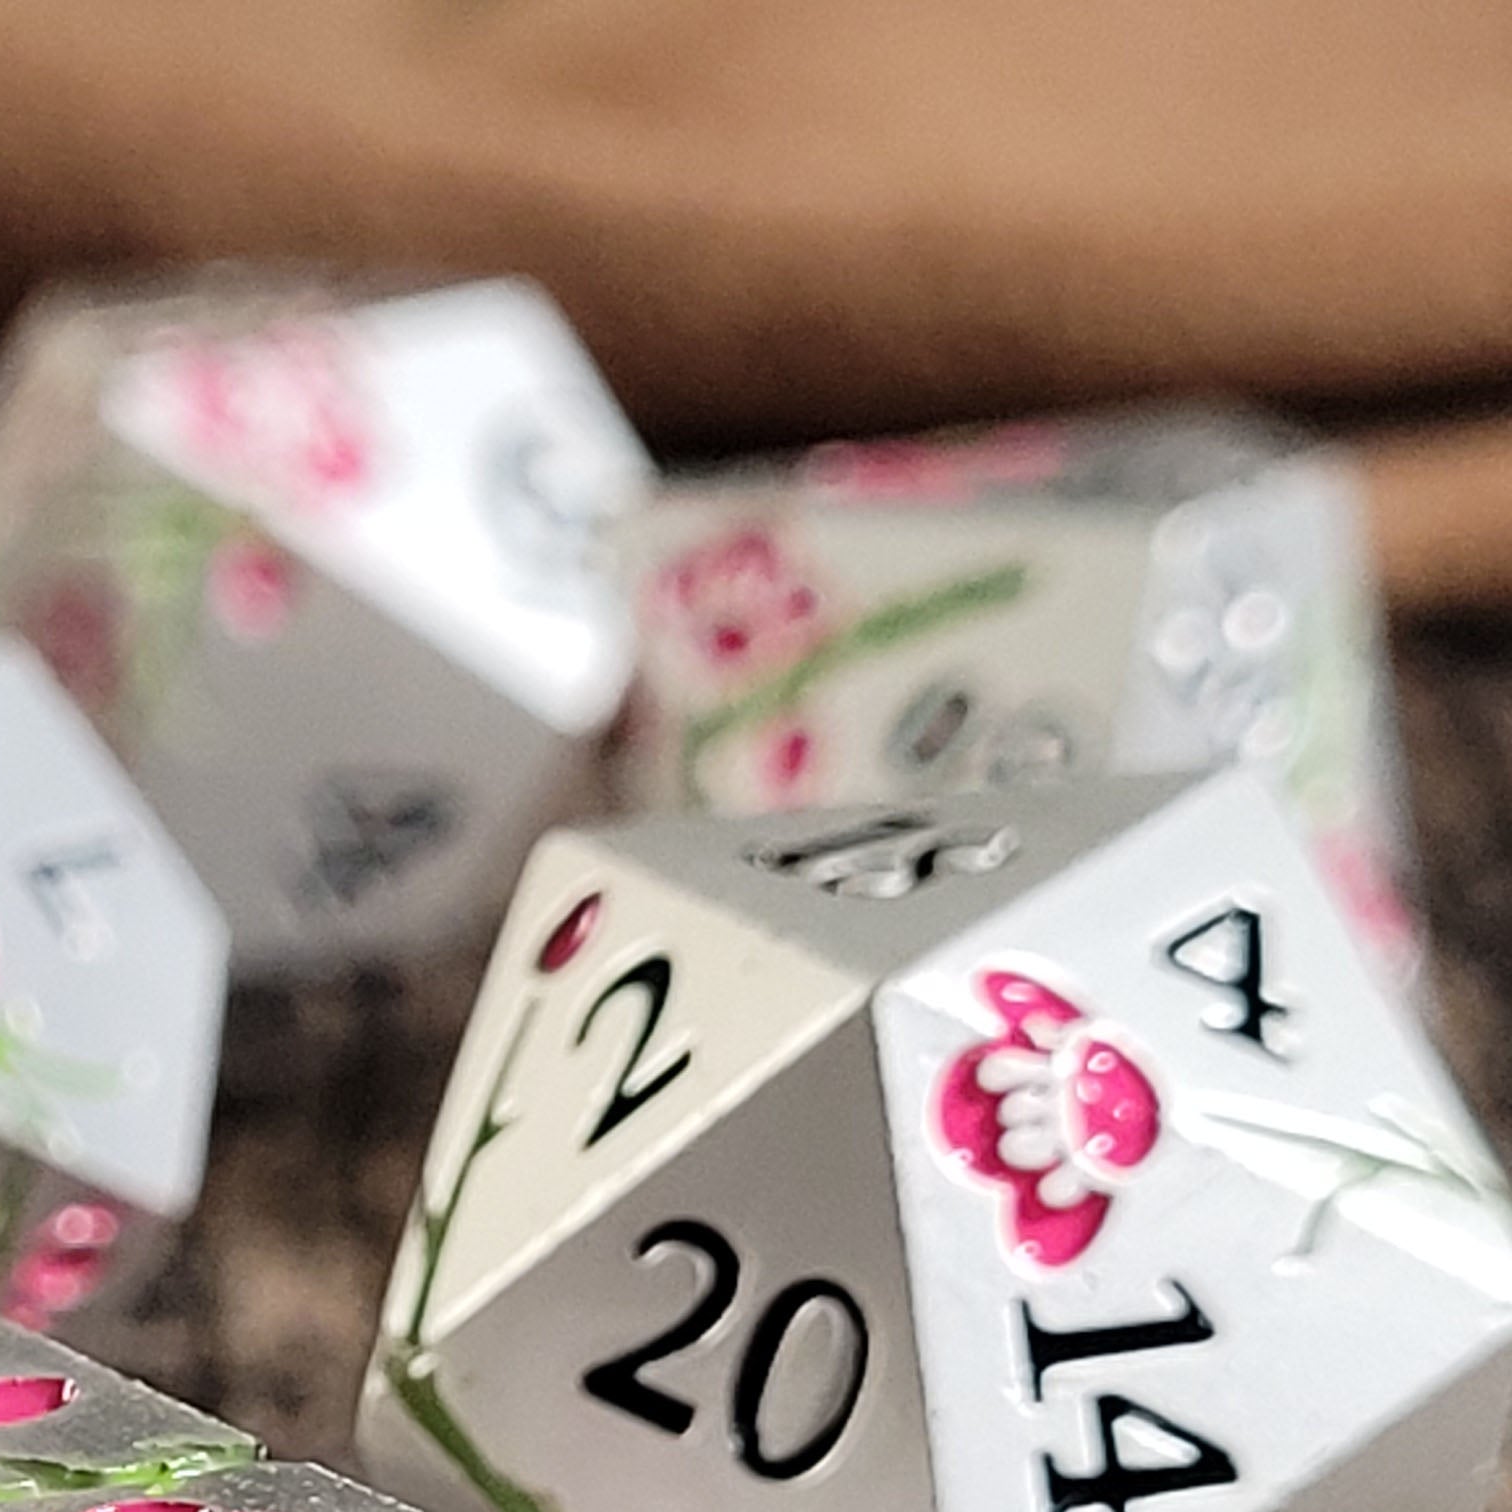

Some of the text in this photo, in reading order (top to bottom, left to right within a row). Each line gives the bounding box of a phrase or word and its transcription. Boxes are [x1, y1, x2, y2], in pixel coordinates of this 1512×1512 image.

[576, 955, 692, 1150] 2
[1168, 905, 1291, 1065] 4
[581, 1220, 870, 1482] 20
